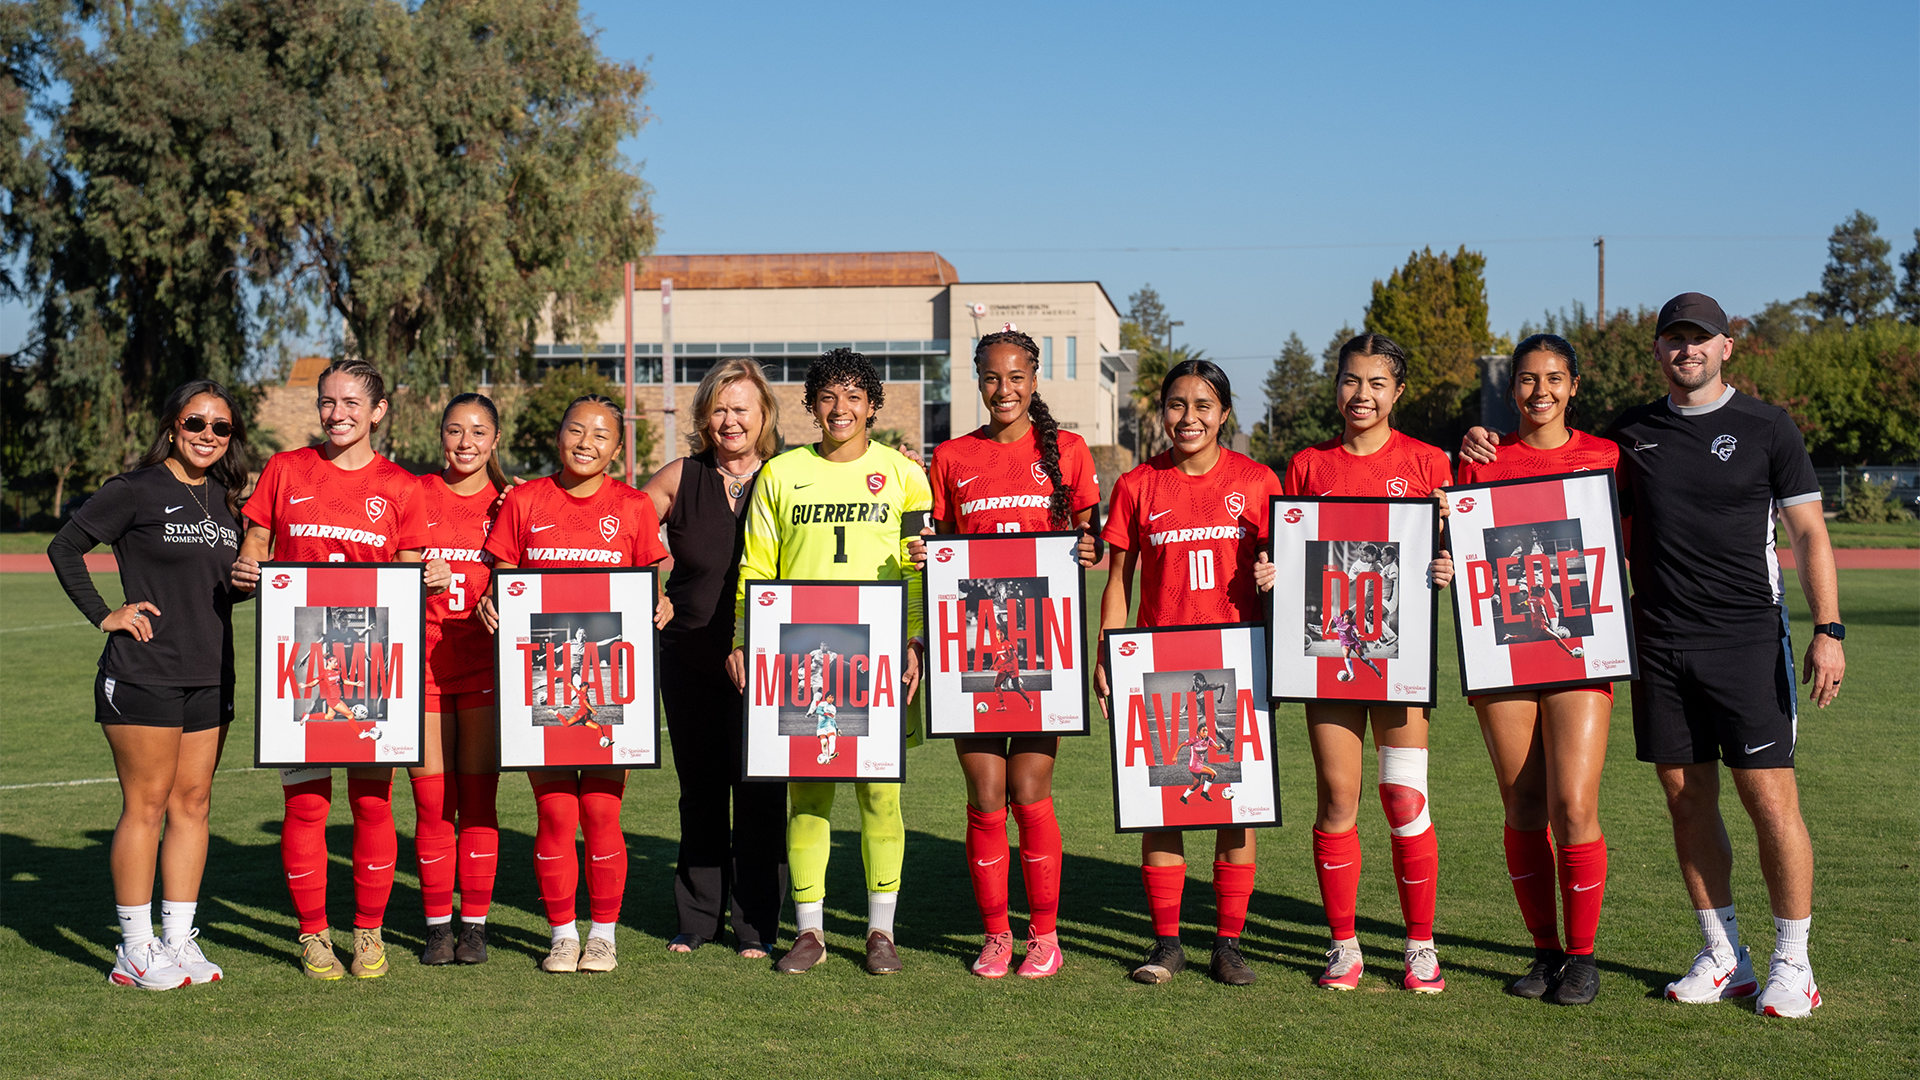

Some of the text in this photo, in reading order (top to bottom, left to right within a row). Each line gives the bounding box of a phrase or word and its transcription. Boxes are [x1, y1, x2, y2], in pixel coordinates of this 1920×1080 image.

[869, 475, 883, 490] S
[1390, 482, 1403, 496] S
[369, 500, 382, 516] S
[791, 503, 890, 526] GUERRERAS
[960, 494, 1051, 516] WARRIORS
[1228, 496, 1242, 513] S
[164, 523, 200, 535] STAN
[288, 523, 387, 548] WARRIORS
[603, 519, 616, 535] S
[1148, 525, 1247, 547] WARRIORS
[163, 535, 204, 544] WOMEN'S
[833, 526, 848, 563] 1
[421, 547, 495, 562] ARRIOR
[526, 547, 623, 565] WARRIORS
[1188, 549, 1216, 591] 10
[1466, 547, 1614, 627] PEREZ
[1322, 570, 1383, 641] DO
[938, 597, 1074, 673] HAHN
[277, 642, 403, 699] KAMM
[516, 641, 636, 706] THAO
[755, 653, 895, 708] MUJICA
[1125, 688, 1264, 767] AVILA
